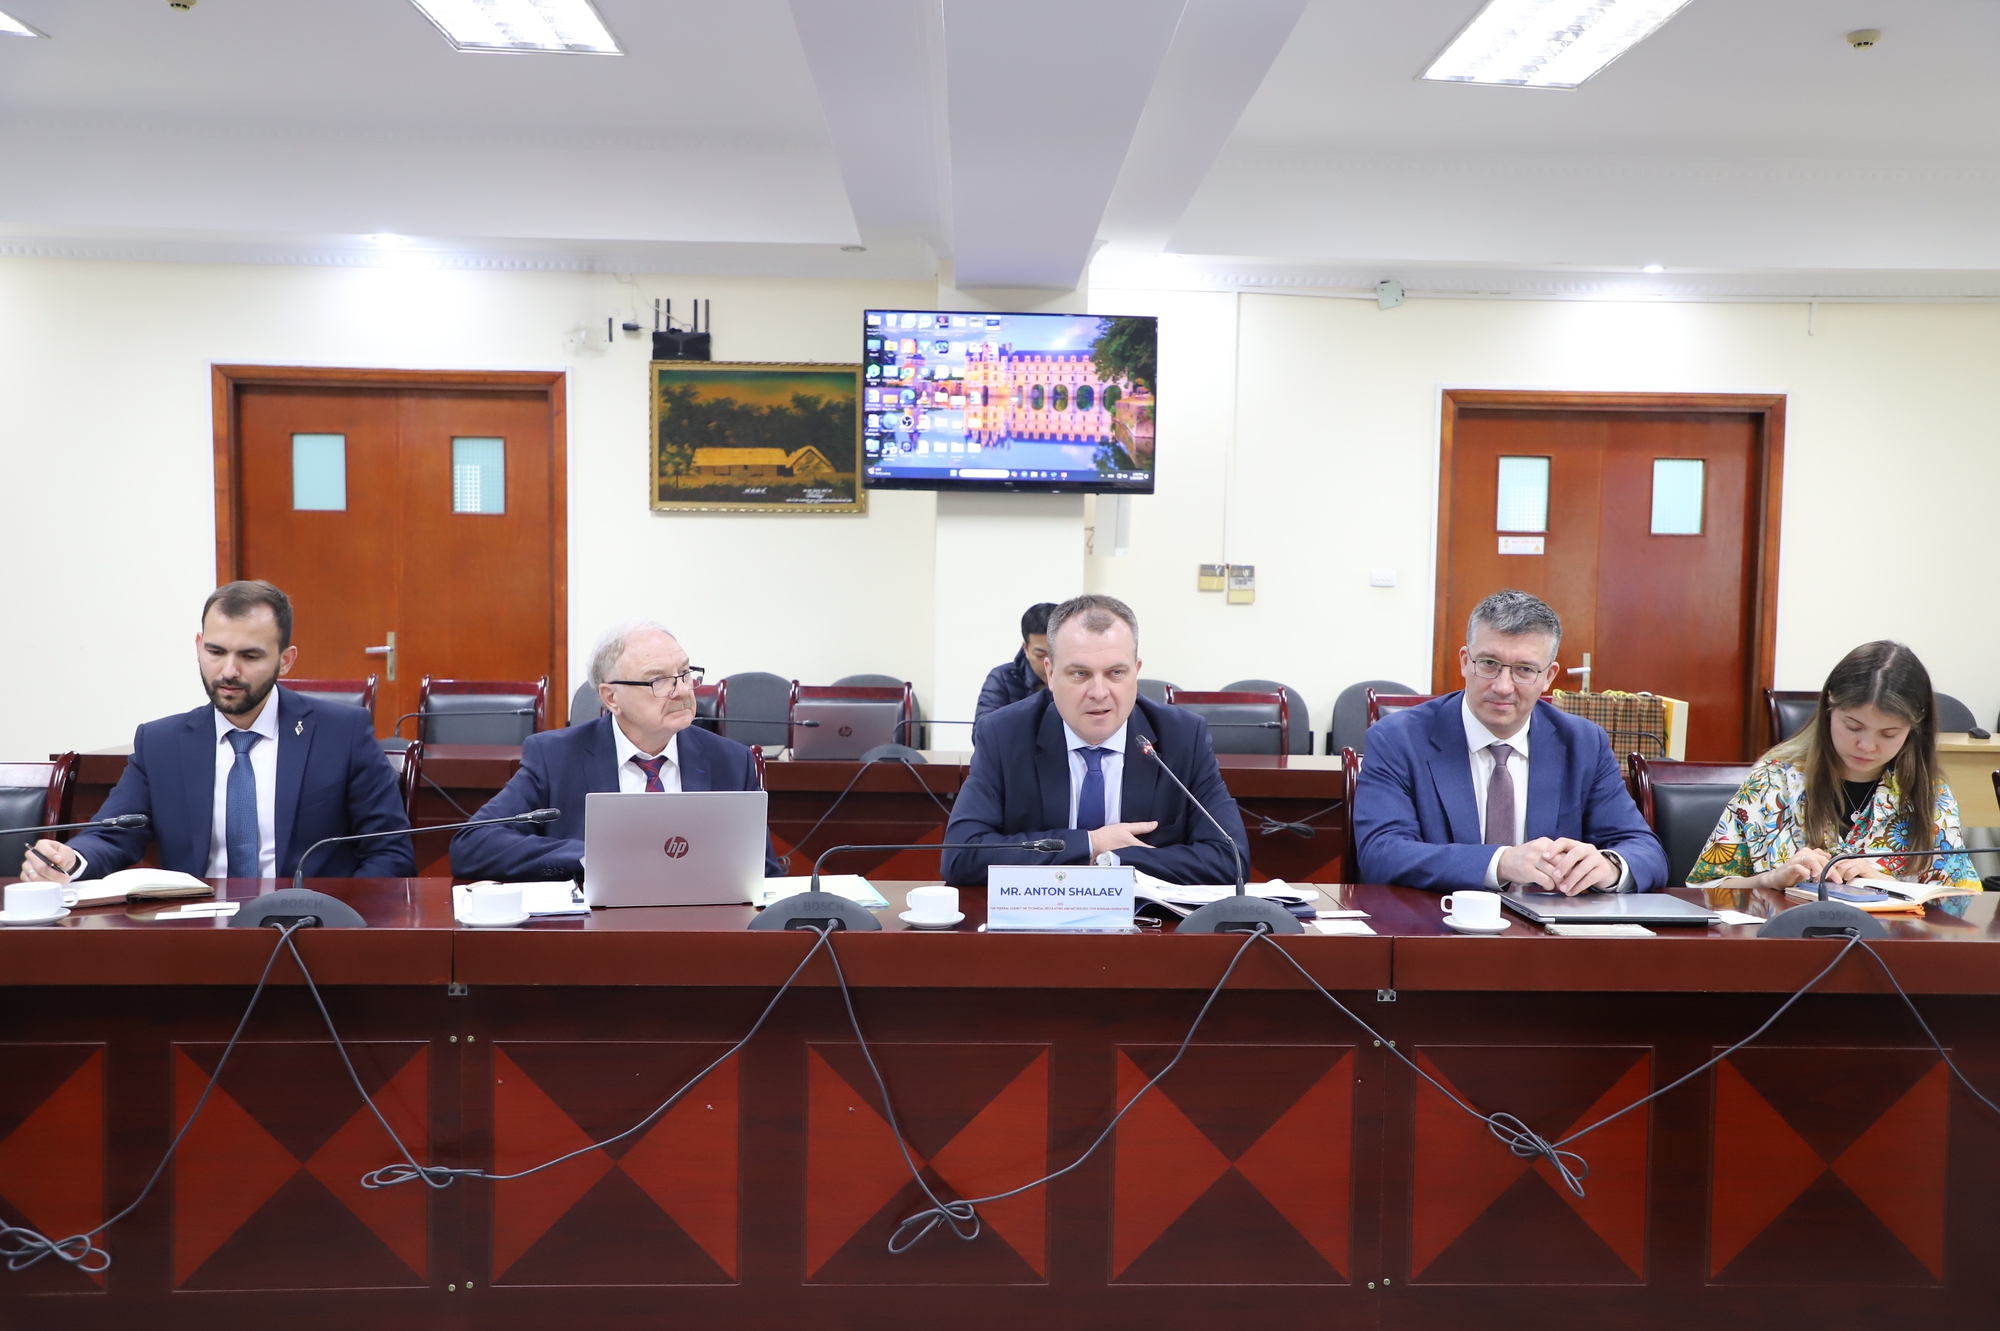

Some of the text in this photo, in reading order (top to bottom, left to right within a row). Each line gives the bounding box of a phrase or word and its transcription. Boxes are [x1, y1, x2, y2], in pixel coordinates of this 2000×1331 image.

[665, 836, 689, 859] hp
[1000, 887, 1123, 897] MR. ANTON SHALAEV
[280, 899, 323, 909] BOSCH
[803, 901, 844, 912] BOSCH
[1231, 905, 1271, 915] BOSCH
[1820, 910, 1858, 920] BOSCH
